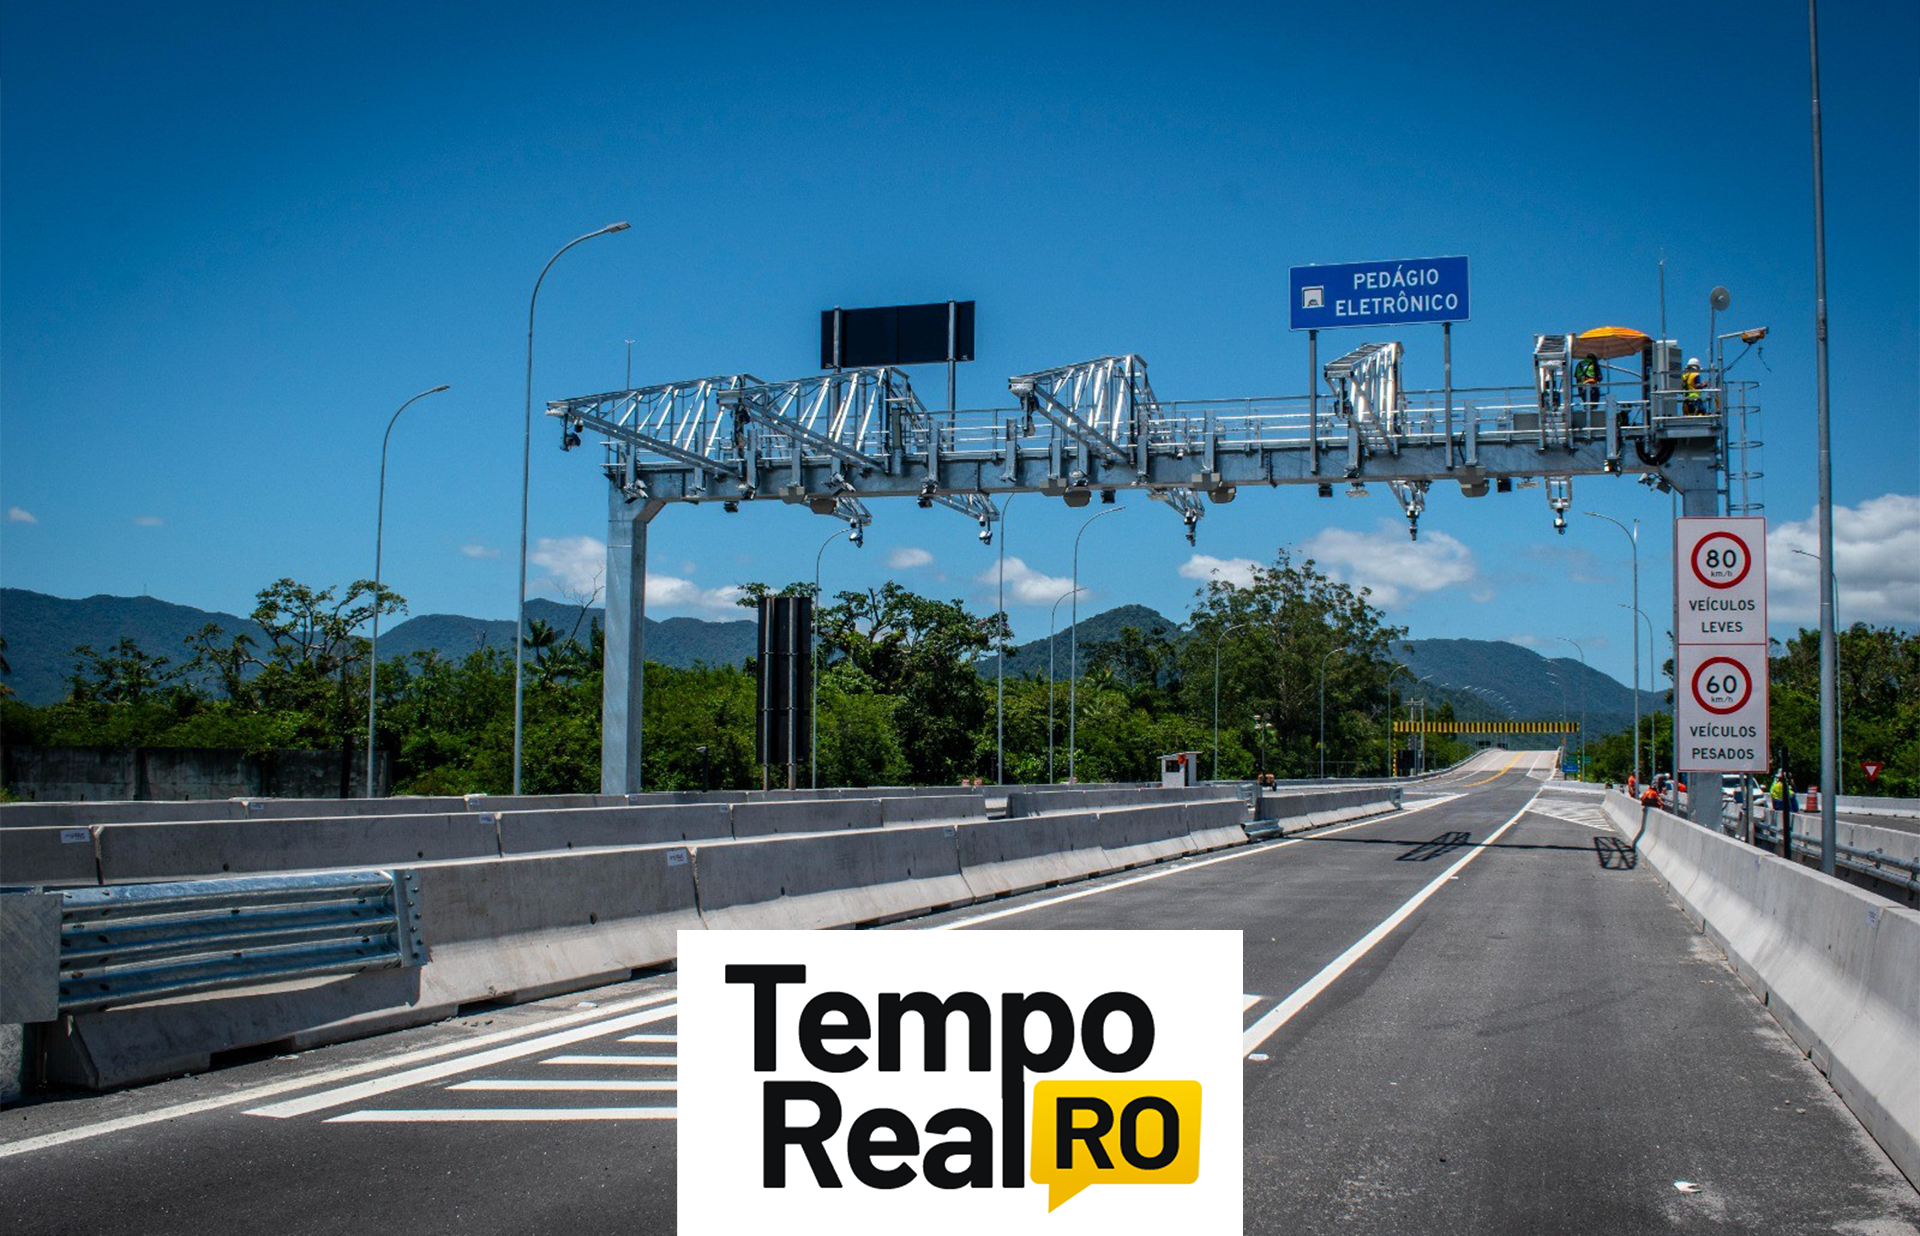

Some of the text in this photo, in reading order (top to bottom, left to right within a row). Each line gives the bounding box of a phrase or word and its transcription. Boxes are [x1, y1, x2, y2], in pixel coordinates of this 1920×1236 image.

[1353, 264, 1439, 290] PEDÁGIO
[1335, 290, 1458, 317] ELETRÔNICO
[1706, 549, 1737, 568] 80
[1688, 597, 1756, 612] VEÍCULOS
[1701, 621, 1743, 633] LEVES
[1706, 674, 1738, 694] 60
[1689, 721, 1757, 738] VEÍCULOS
[1691, 747, 1755, 760] PESADOS
